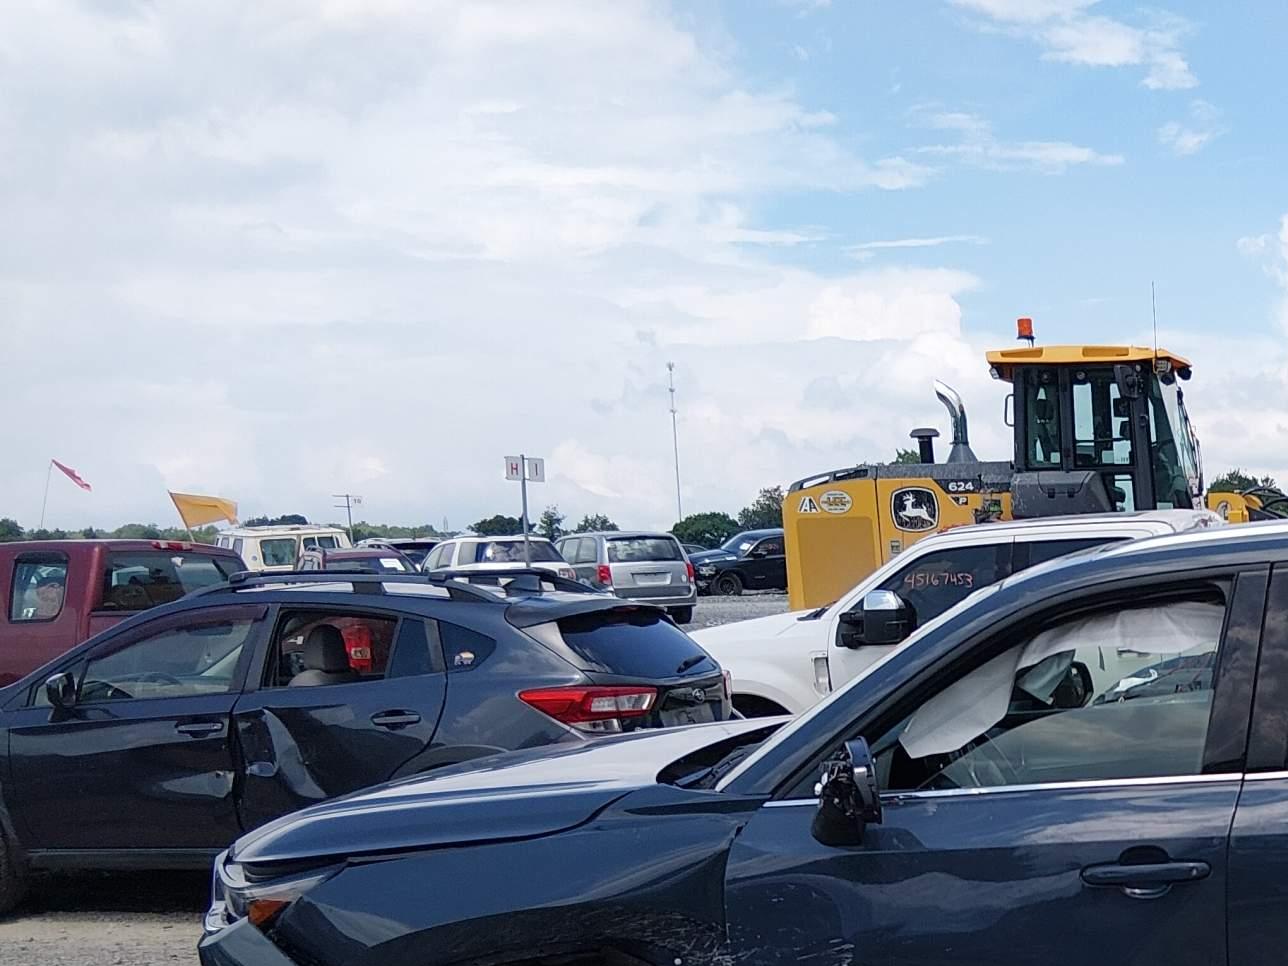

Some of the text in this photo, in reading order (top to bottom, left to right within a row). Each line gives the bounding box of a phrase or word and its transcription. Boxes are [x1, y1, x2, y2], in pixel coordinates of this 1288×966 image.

[510, 462, 518, 476] H
[948, 481, 974, 491] 624
[958, 497, 967, 505] P
[904, 572, 973, 589] 45167453
